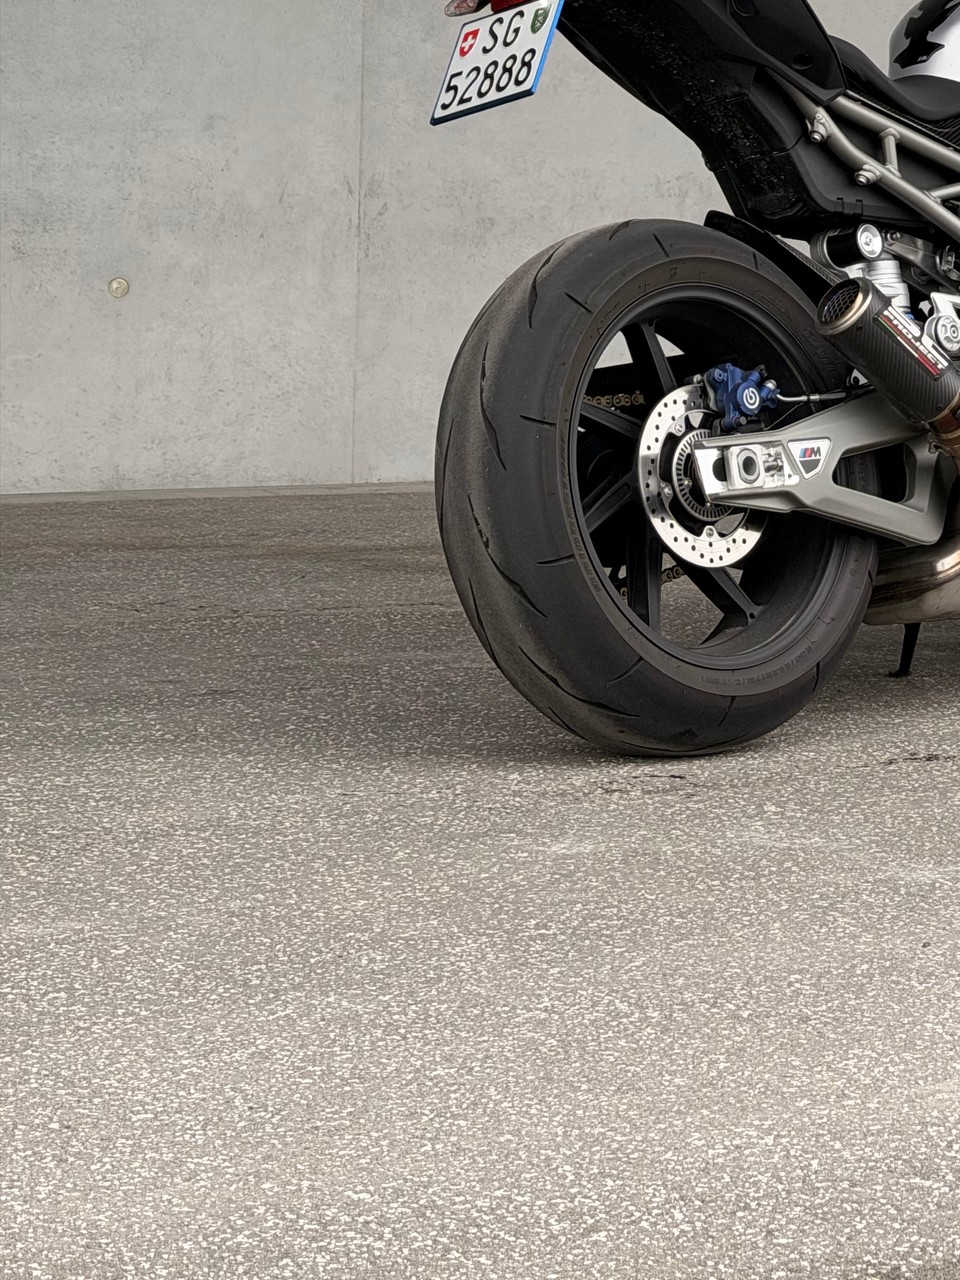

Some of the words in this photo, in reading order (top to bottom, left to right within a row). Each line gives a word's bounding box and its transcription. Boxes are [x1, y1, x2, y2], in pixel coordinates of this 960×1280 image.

[481, 10, 525, 55] SG
[440, 48, 537, 111] 52888
[882, 309, 946, 369] PROJECT
